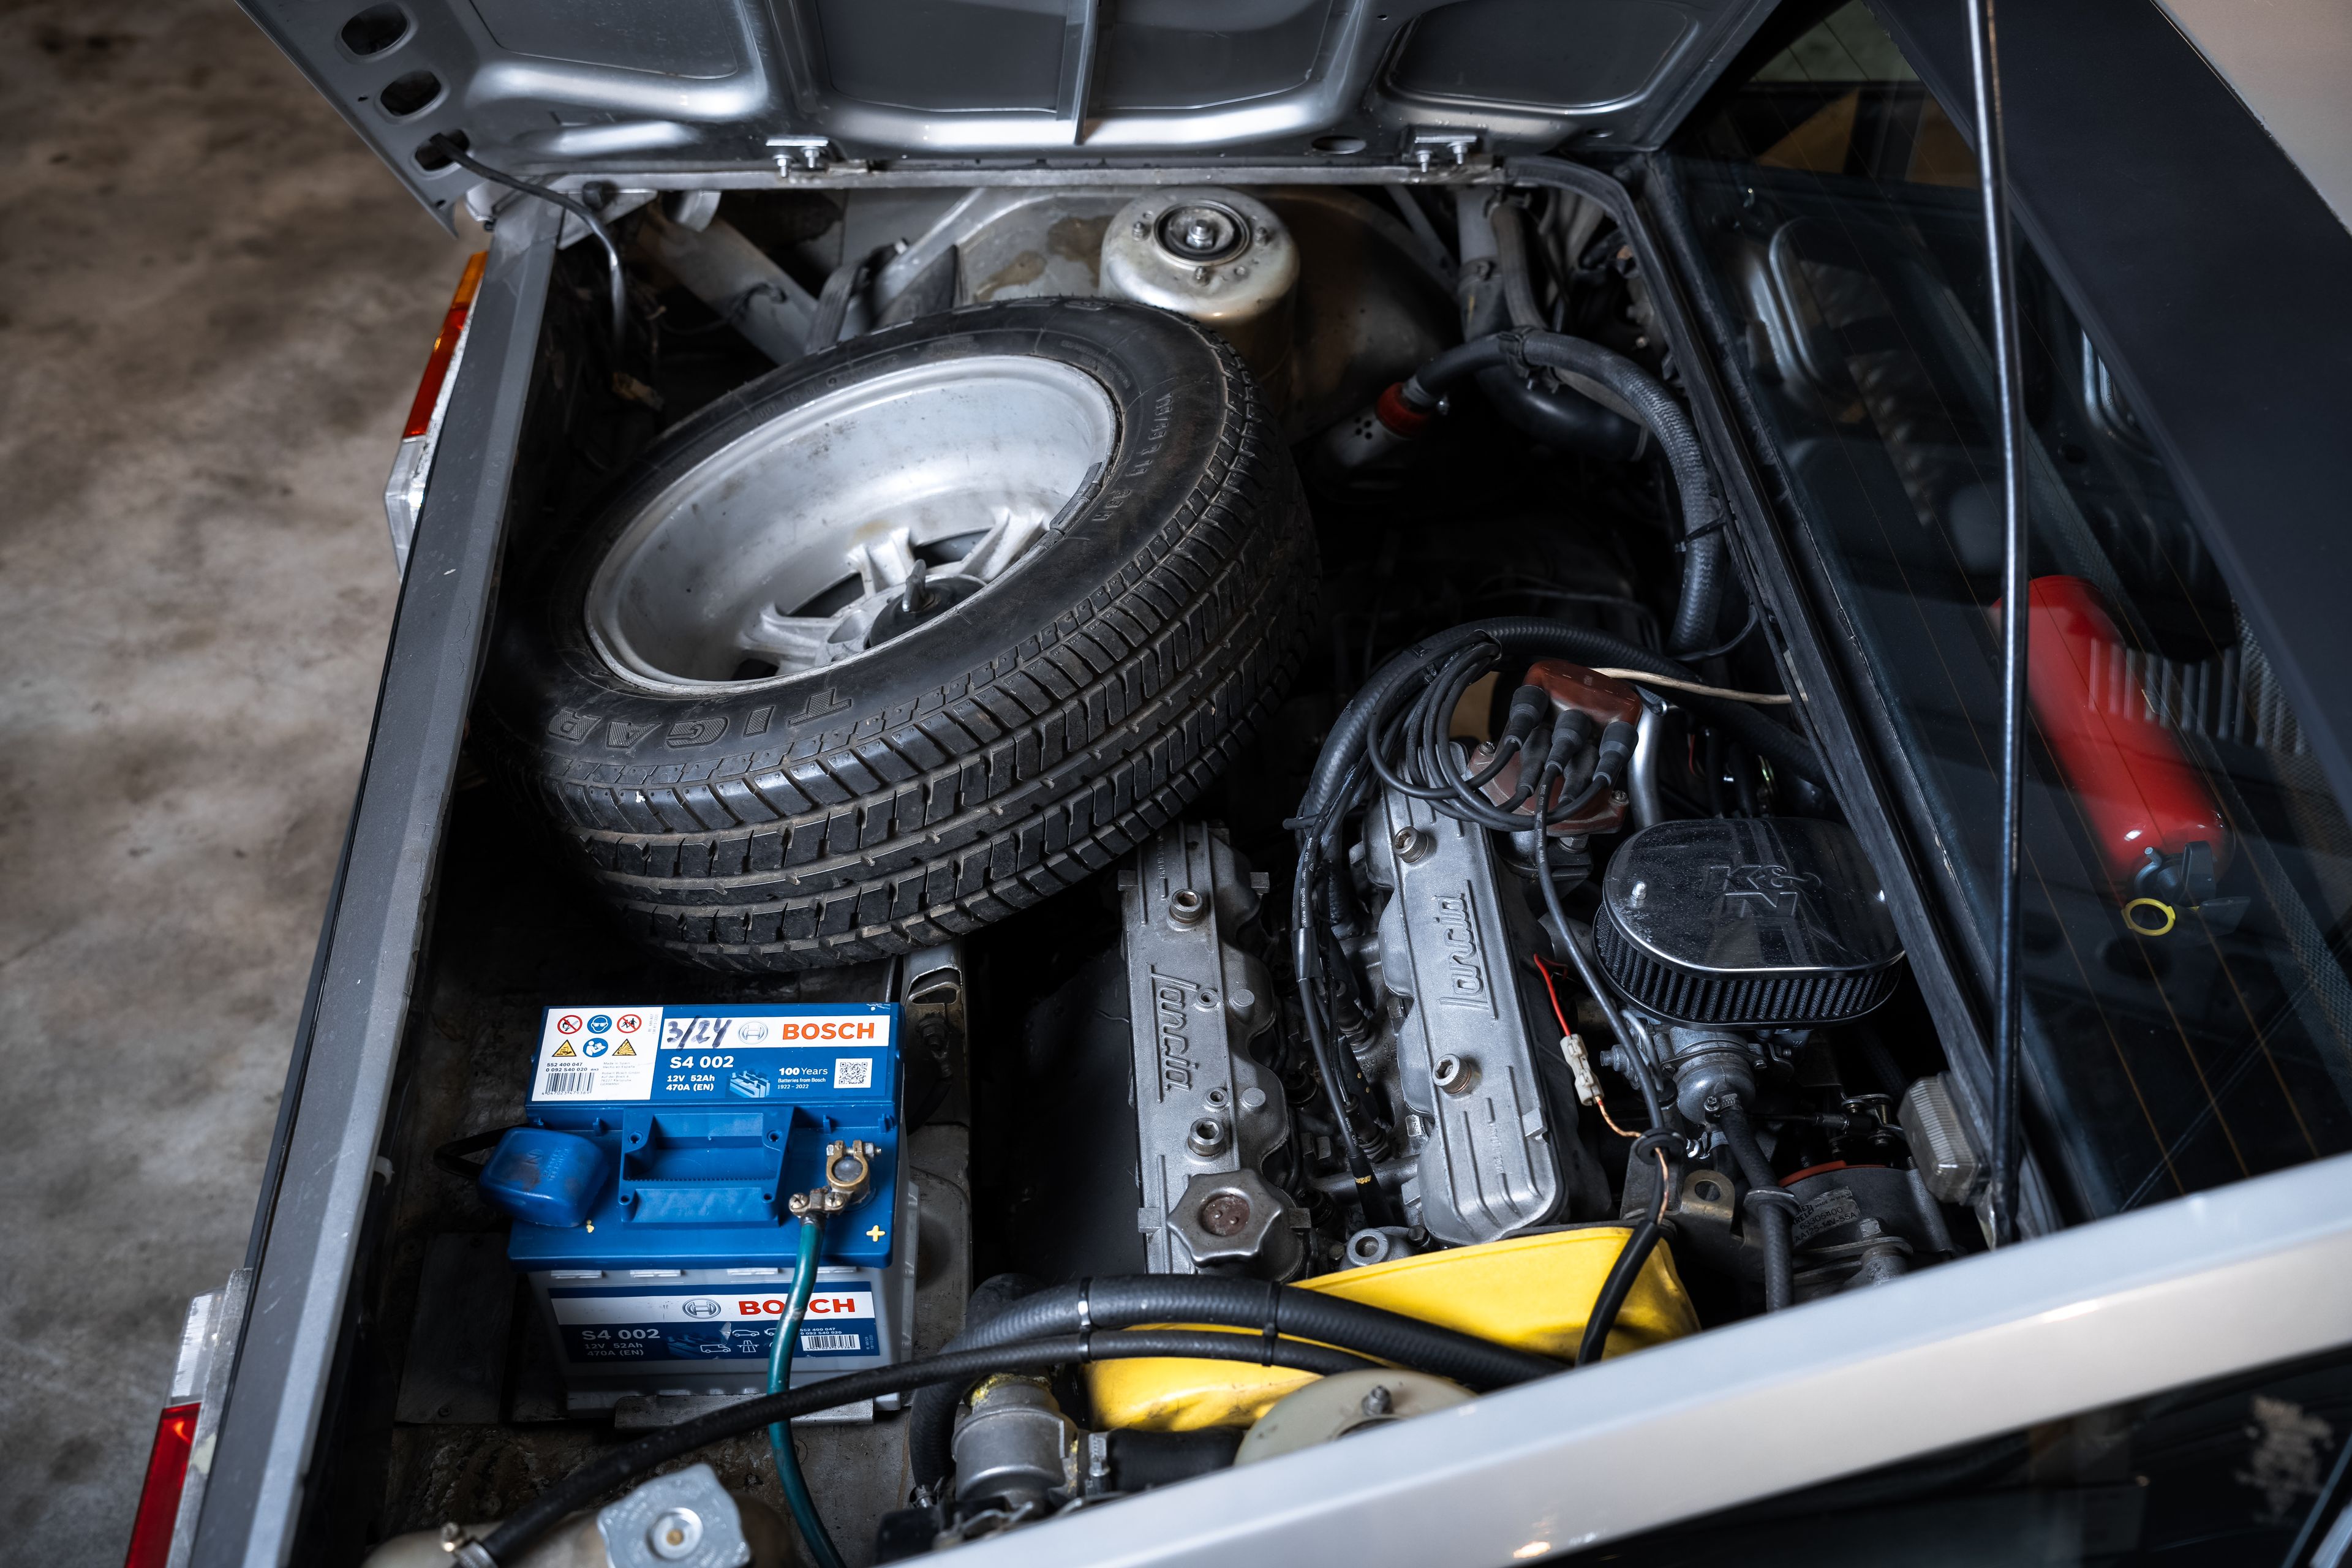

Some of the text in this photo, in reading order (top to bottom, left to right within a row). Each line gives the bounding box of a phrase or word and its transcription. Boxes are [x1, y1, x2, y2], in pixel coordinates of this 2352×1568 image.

[548, 687, 851, 749] TIGAR
[782, 1022, 875, 1040] BOSCH
[669, 1055, 734, 1069] S4 002
[778, 1067, 828, 1076] 100 Years
[693, 1083, 714, 1091] (EN)
[738, 1298, 856, 1315] BOCH
[582, 1329, 661, 1340] S4 002
